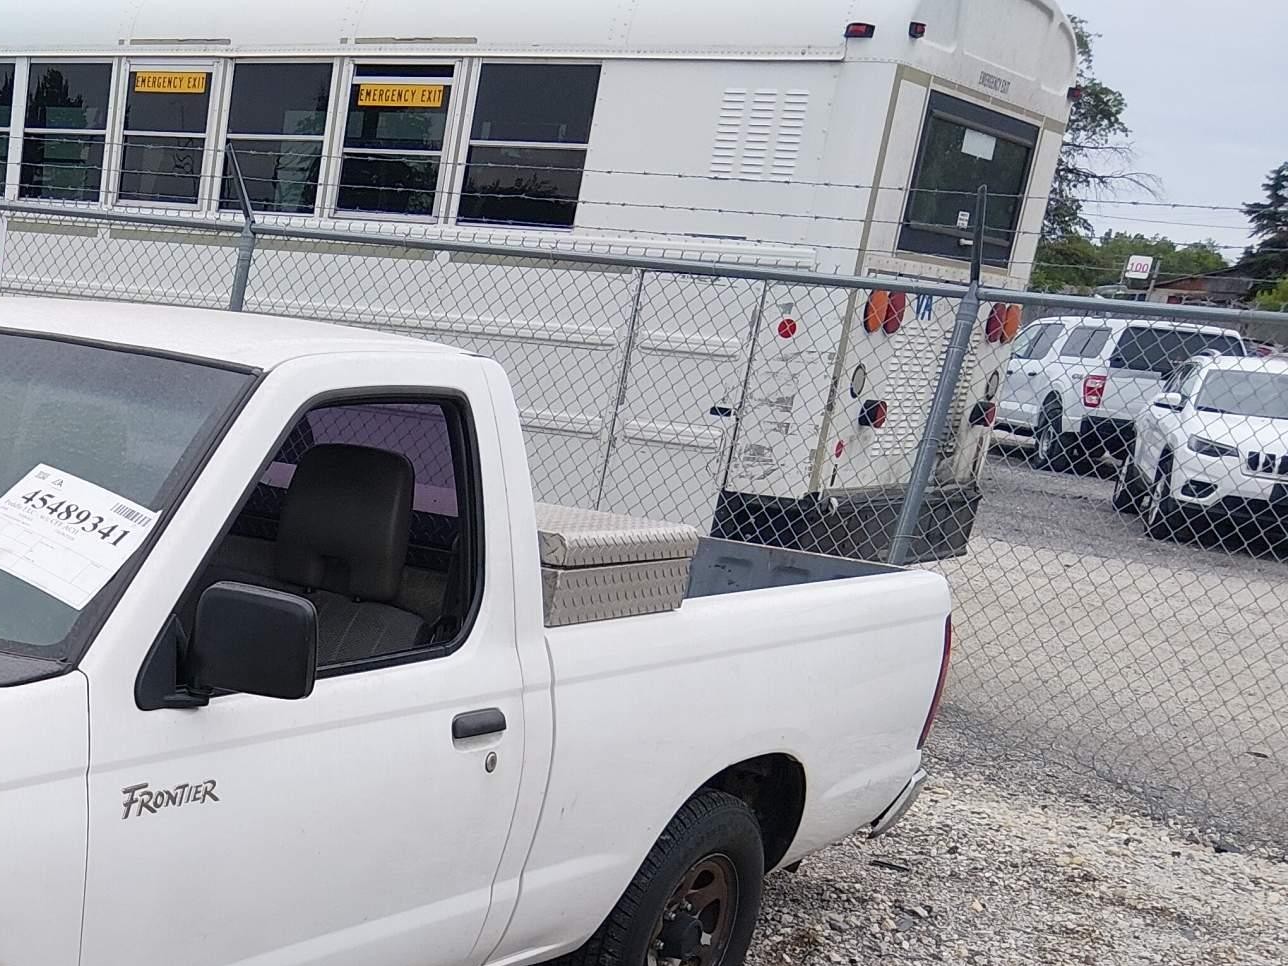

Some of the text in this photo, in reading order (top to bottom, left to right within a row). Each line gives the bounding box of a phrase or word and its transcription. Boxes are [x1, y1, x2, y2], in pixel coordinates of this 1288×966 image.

[135, 75, 205, 89] EMERGENCY EXIT
[359, 88, 442, 103] EMERGENCY EXIT
[1130, 262, 1149, 273] 100
[21, 489, 130, 547] 45489341
